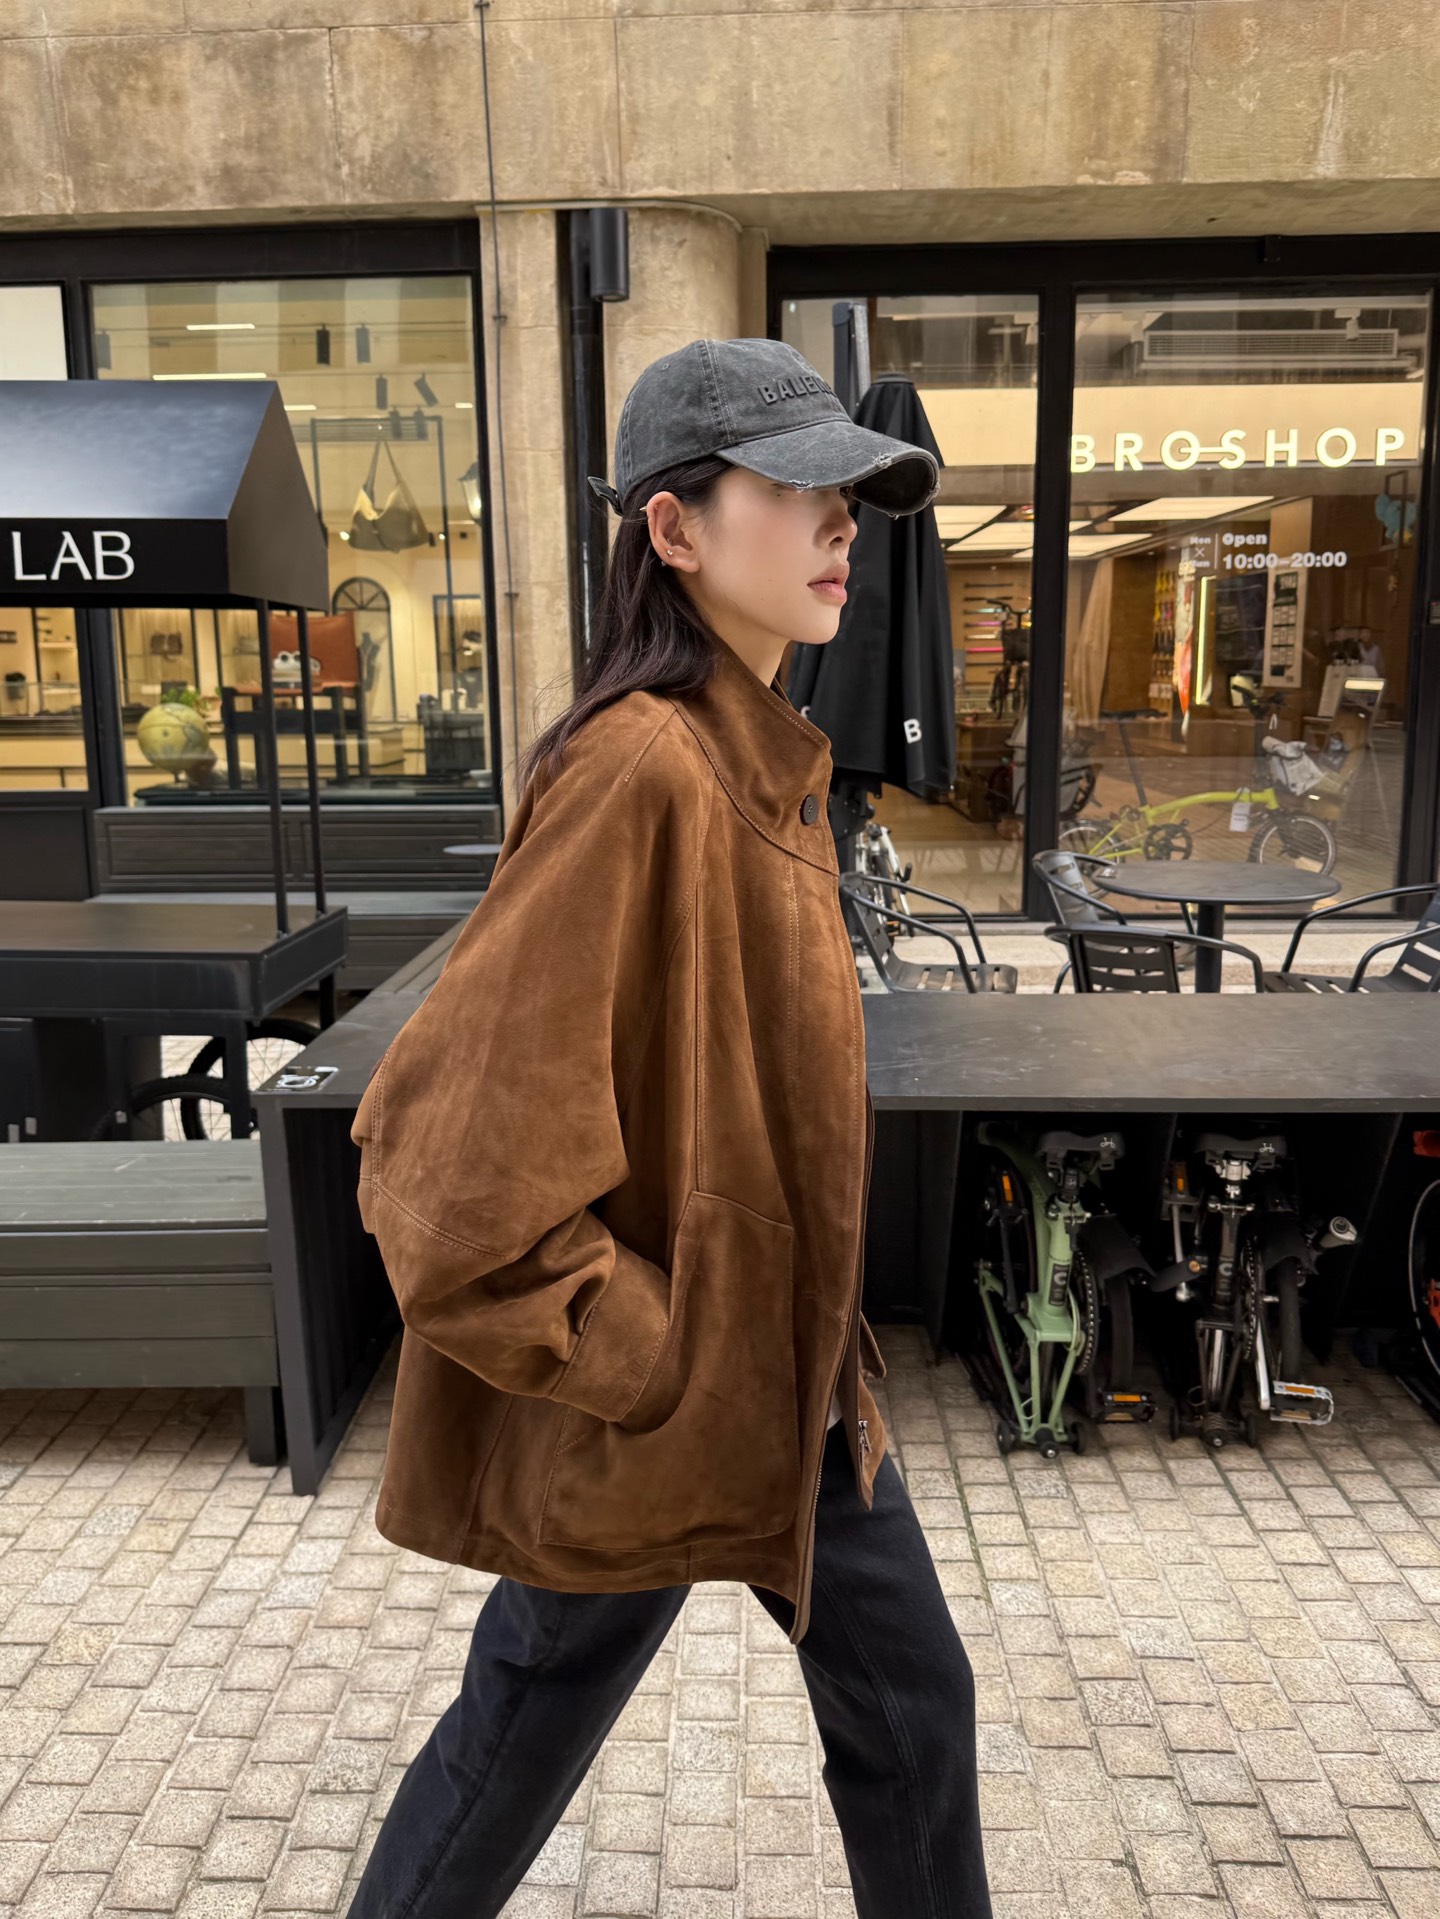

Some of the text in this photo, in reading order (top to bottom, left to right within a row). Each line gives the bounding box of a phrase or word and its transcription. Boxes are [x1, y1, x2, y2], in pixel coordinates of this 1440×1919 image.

[1222, 532, 1267, 547] Open
[11, 530, 135, 581] LAB
[903, 718, 922, 744] B
